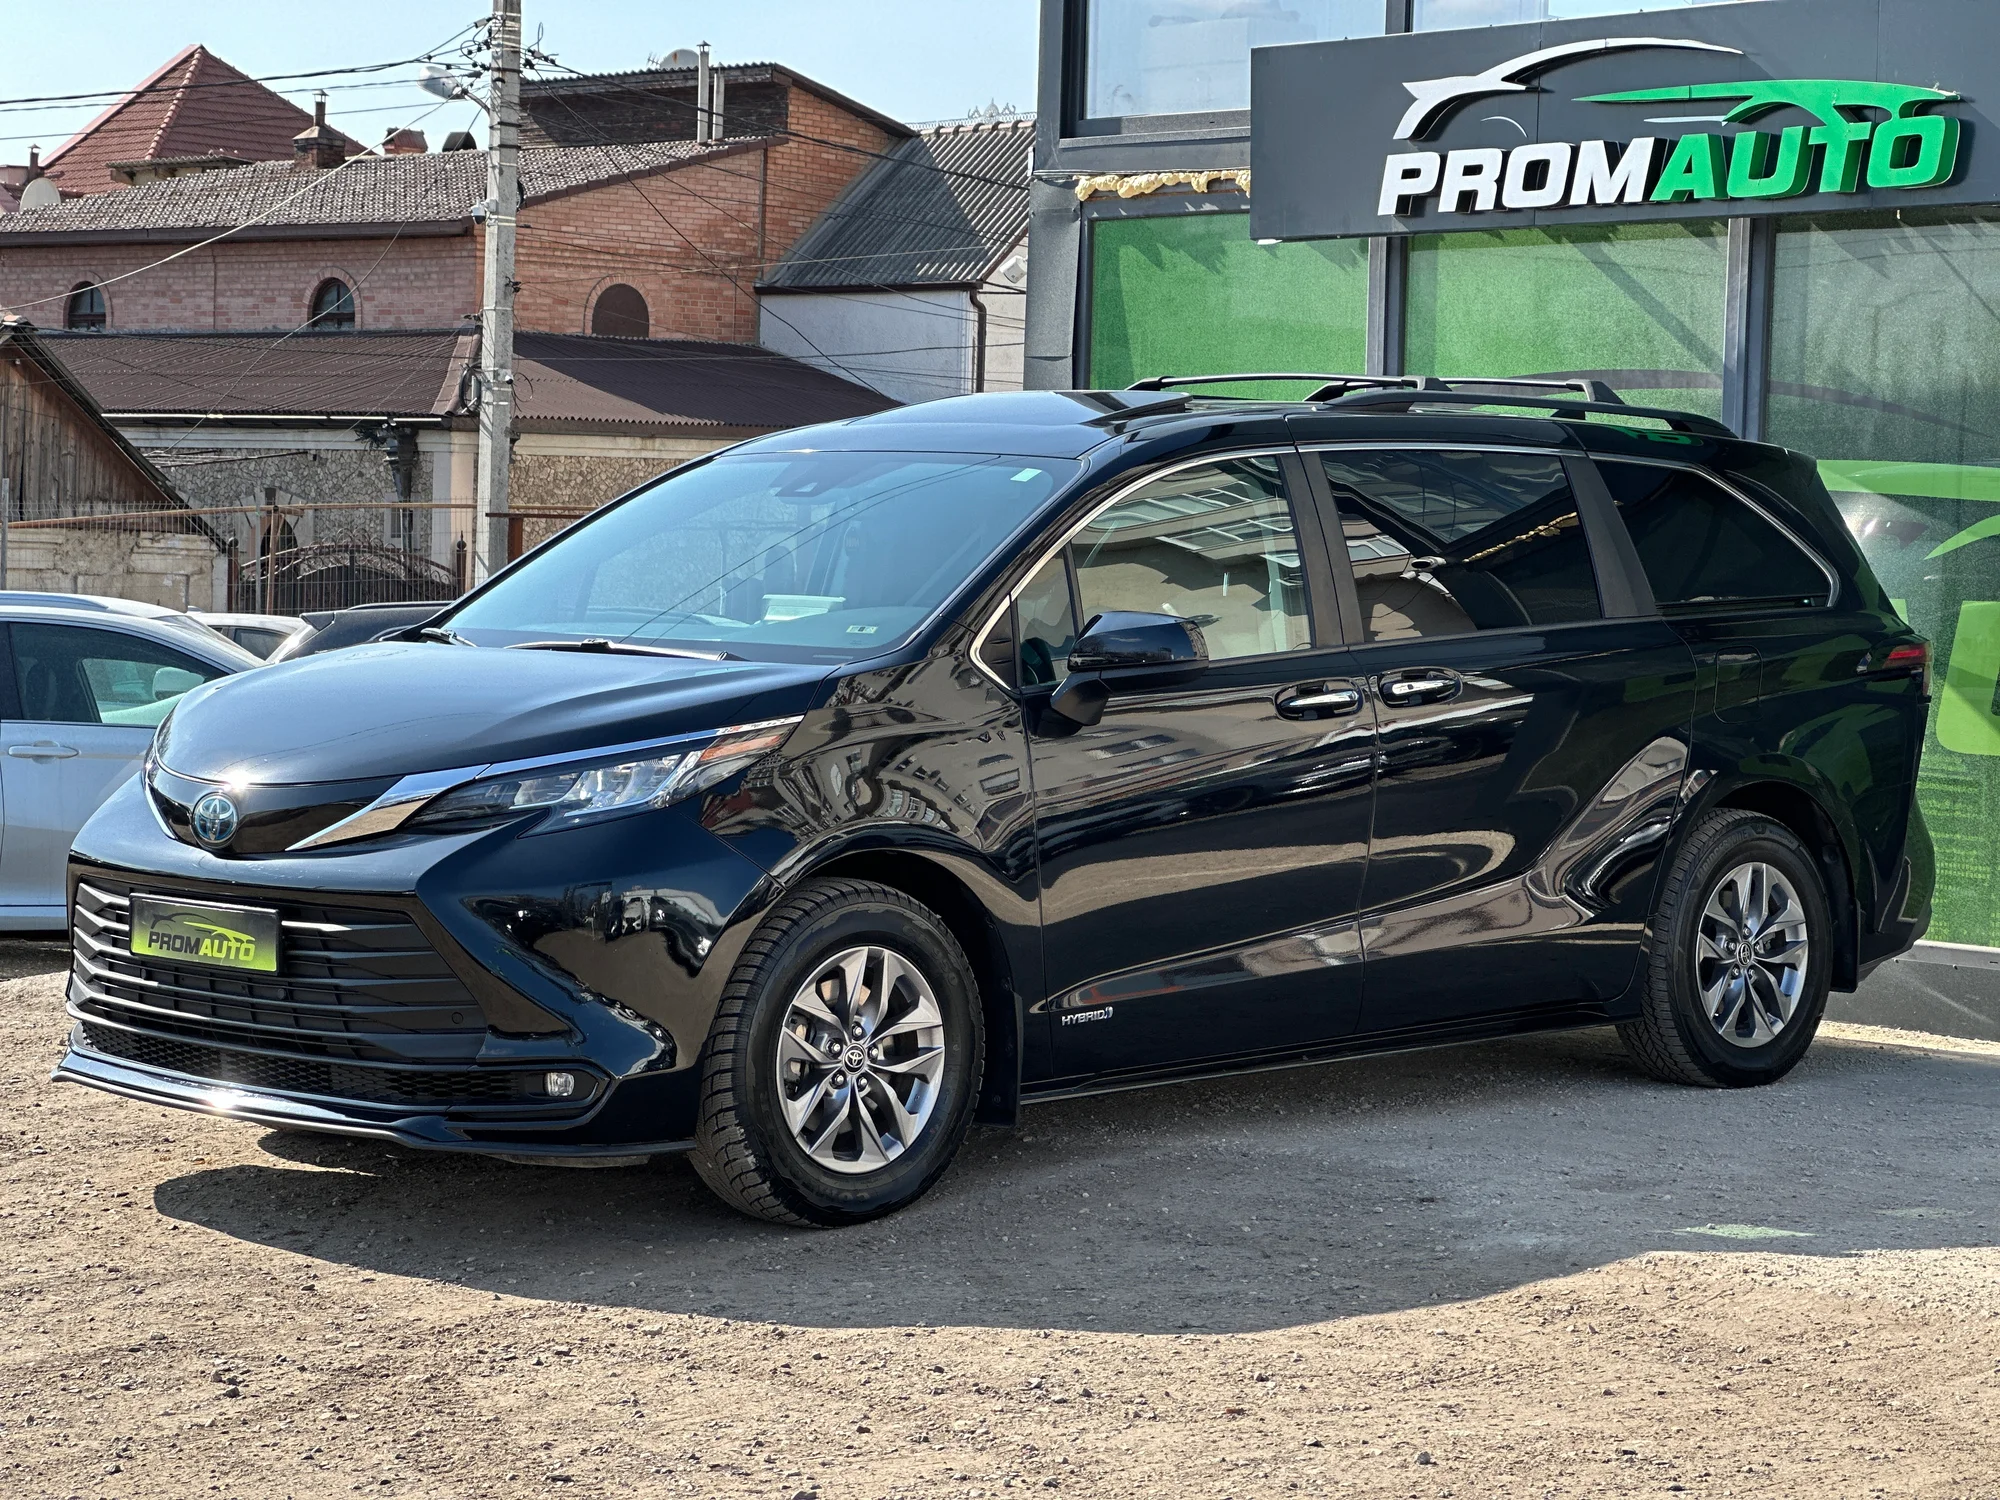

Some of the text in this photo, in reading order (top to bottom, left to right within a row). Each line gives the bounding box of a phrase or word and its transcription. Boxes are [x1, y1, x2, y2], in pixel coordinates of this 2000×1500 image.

[1377, 114, 1961, 216] PROMAUTO
[148, 930, 256, 962] PROMAUTO
[1061, 1009, 1105, 1026] HYBRID
